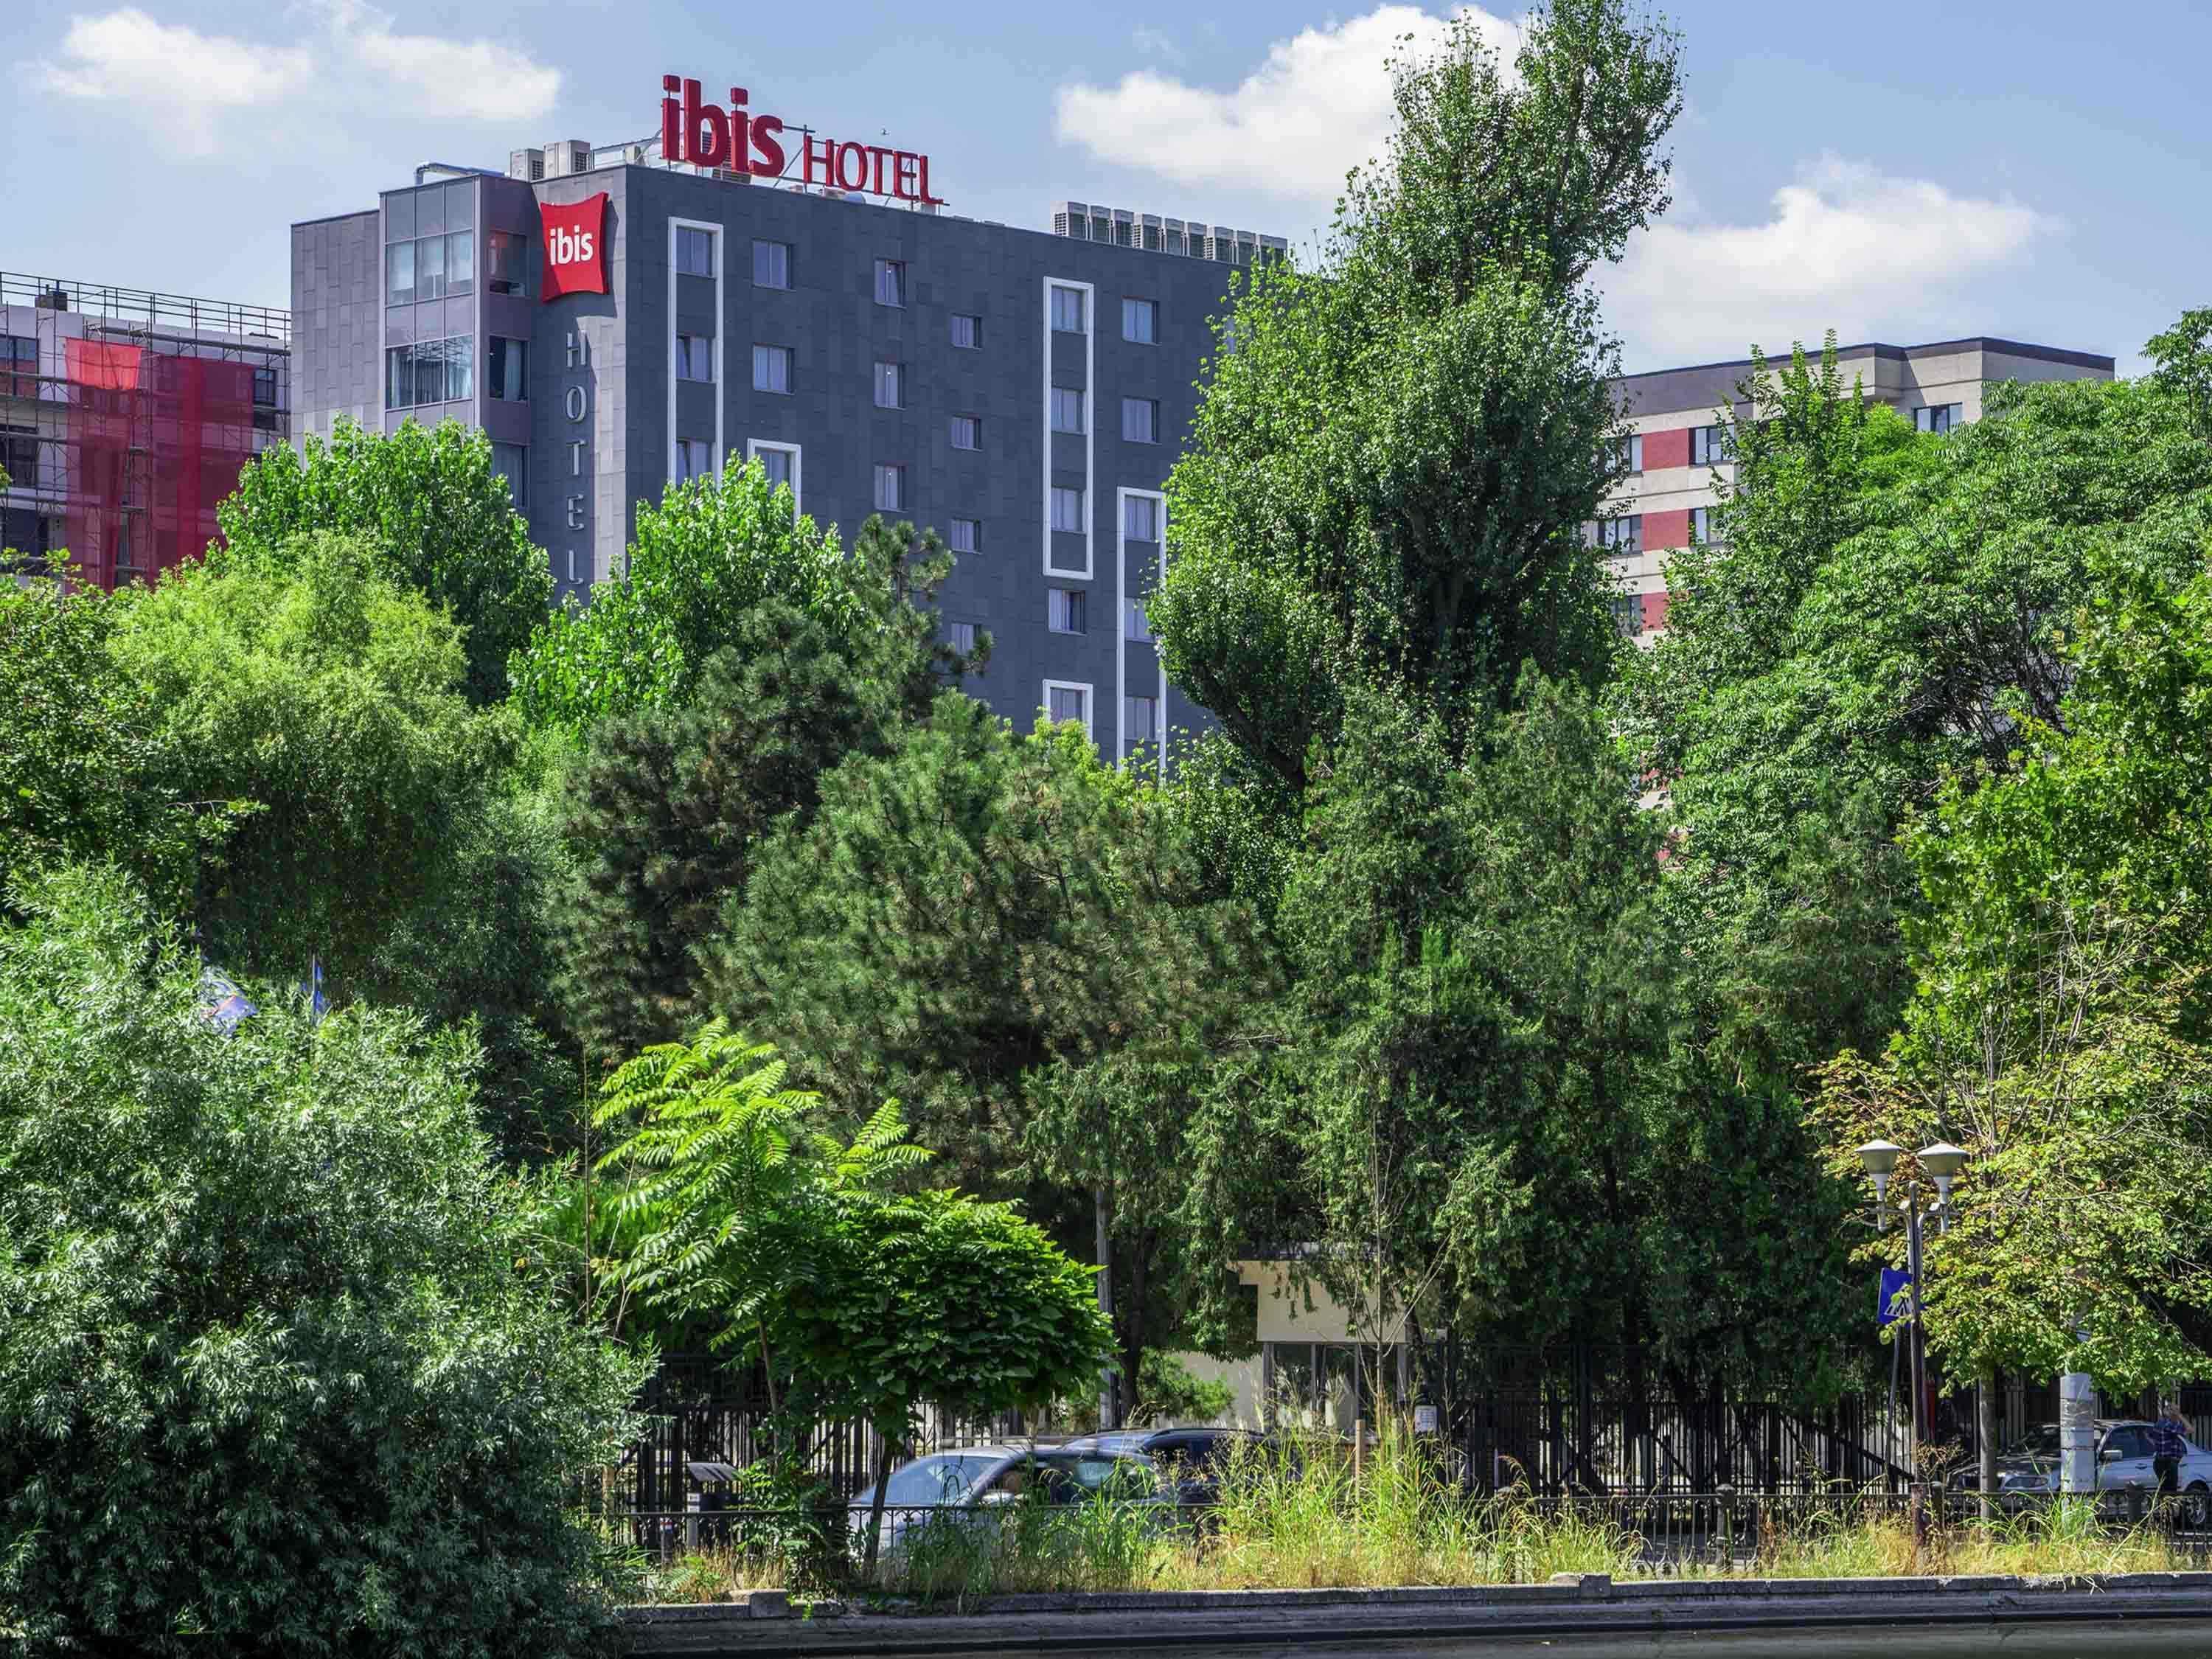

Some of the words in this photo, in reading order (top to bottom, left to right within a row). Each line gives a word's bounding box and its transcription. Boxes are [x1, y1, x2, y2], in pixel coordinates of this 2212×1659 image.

[662, 74, 786, 178] ibis
[804, 135, 944, 205] HOTEL
[549, 225, 594, 266] ibis
[566, 330, 588, 585] HOTEL
